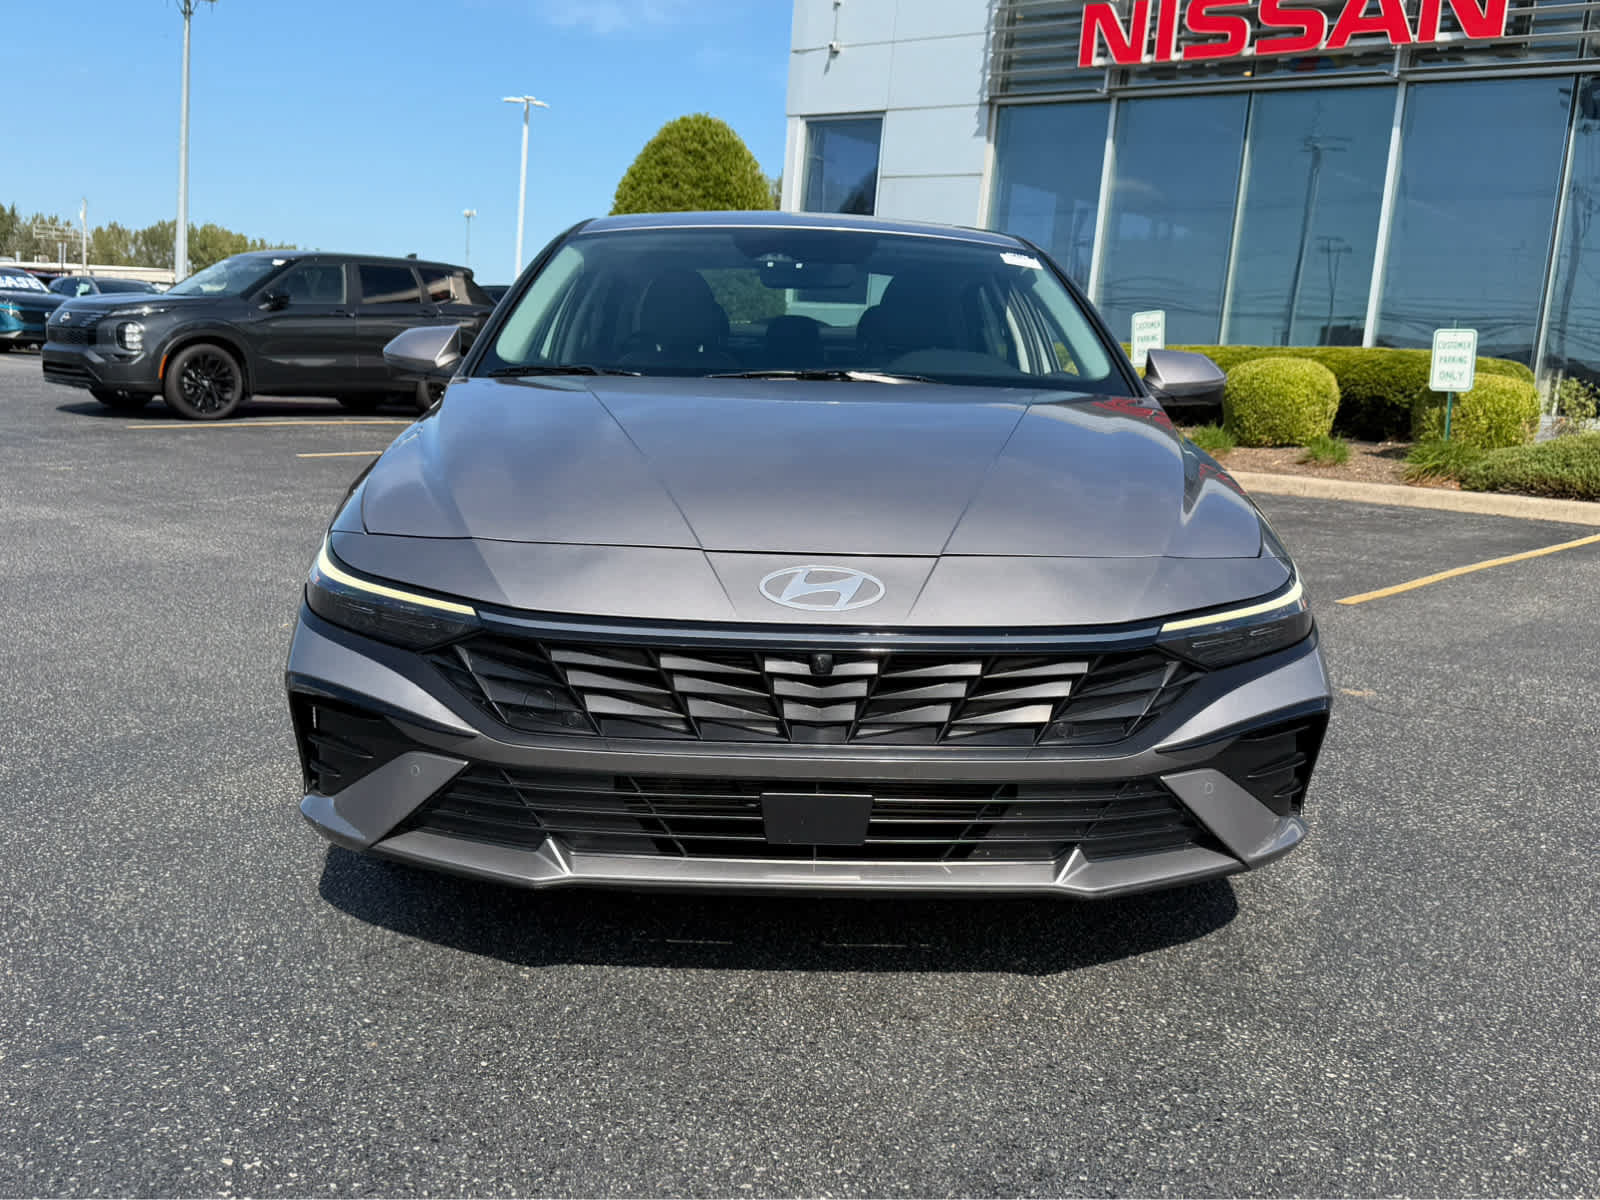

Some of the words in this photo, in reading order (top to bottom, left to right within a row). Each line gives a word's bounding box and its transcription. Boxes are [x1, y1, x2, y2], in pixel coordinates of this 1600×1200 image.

[1077, 0, 1508, 68] NISSAN
[1438, 341, 1471, 350] CUSTOMER
[1439, 355, 1468, 364] PARKING
[1439, 370, 1465, 380] ONLY
